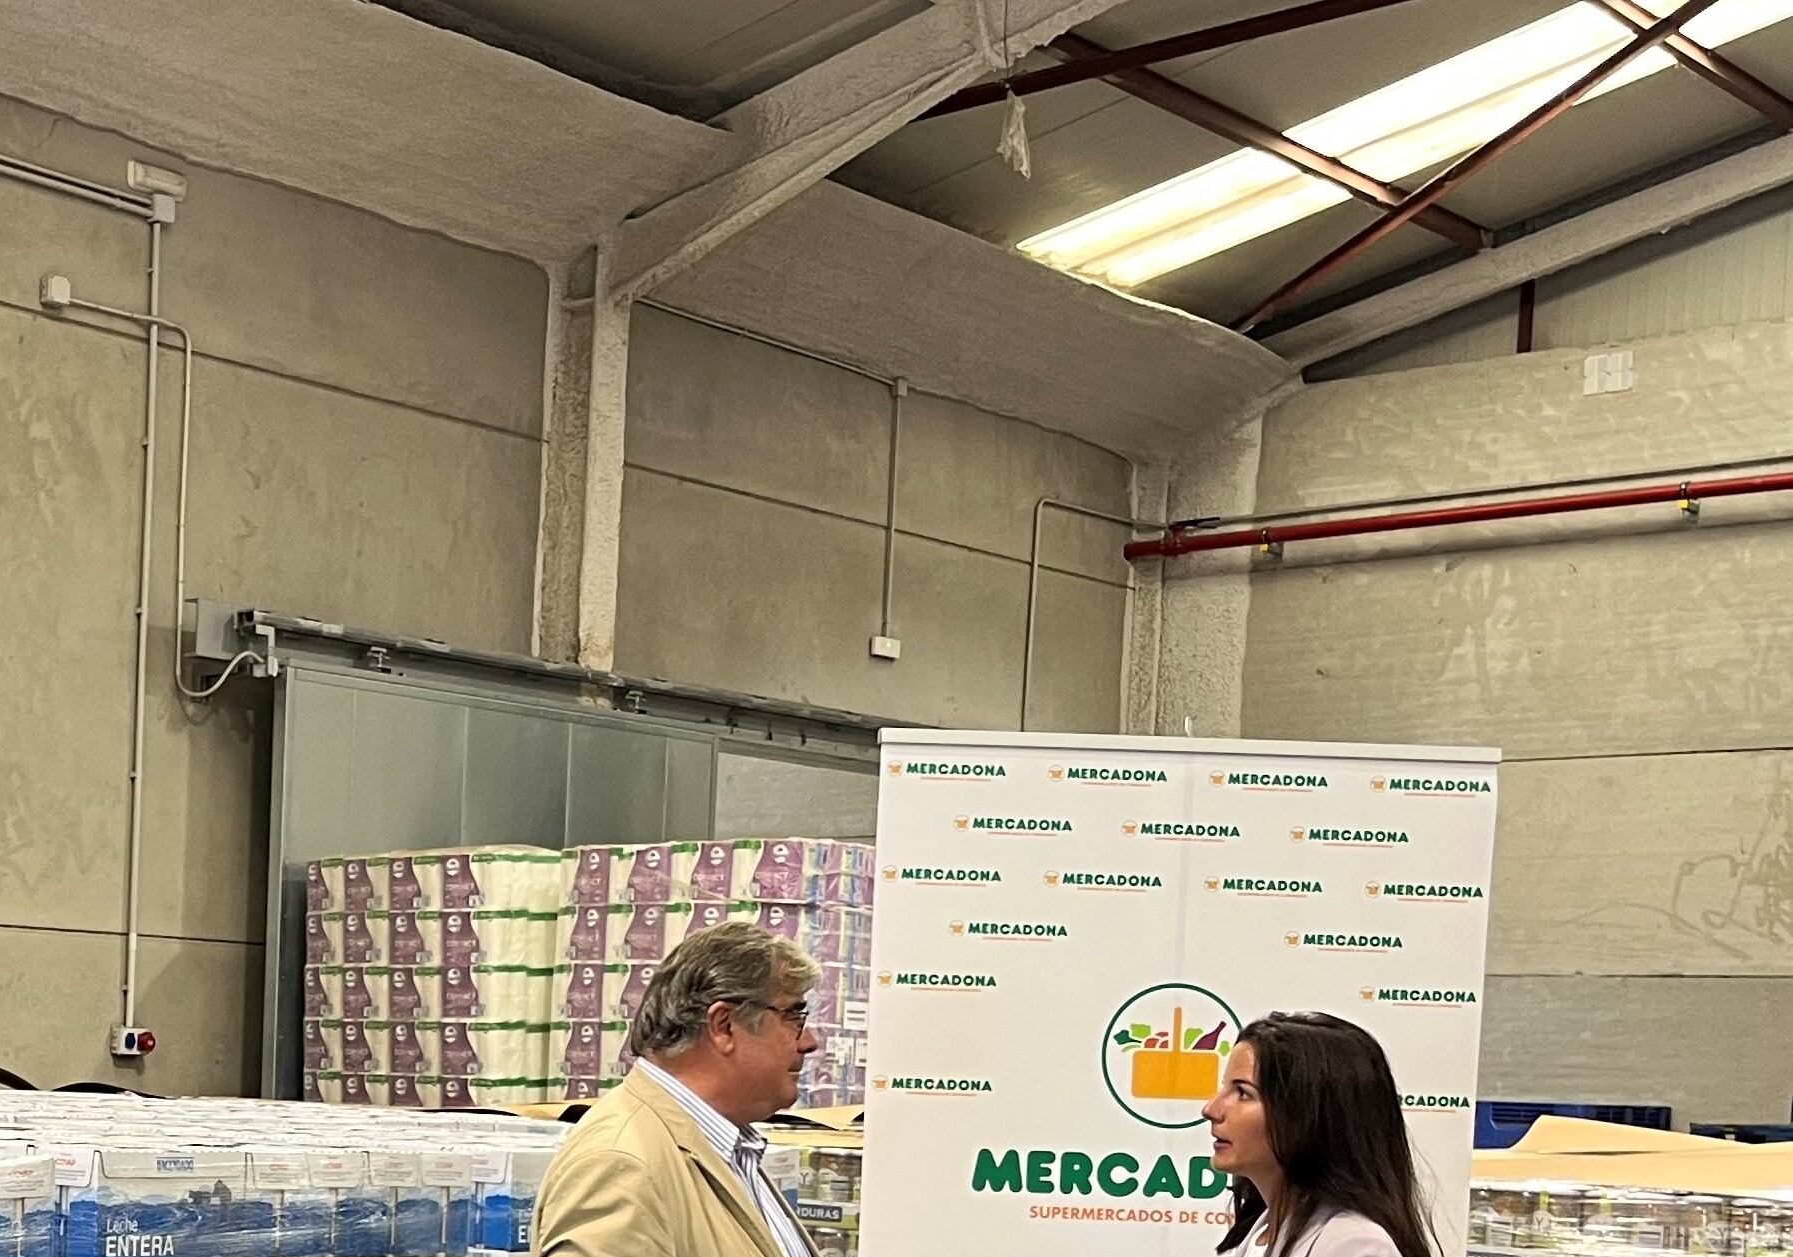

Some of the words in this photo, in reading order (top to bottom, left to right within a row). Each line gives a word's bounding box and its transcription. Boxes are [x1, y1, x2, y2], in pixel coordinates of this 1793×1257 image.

[906, 763, 1006, 777] MERCADONA
[1067, 767, 1167, 783] MERCADONA
[1228, 773, 1328, 788] MERCADONA
[1389, 778, 1491, 793] MERCADONA
[972, 818, 1073, 832] MERCADONA
[1140, 823, 1241, 838] MERCADONA
[1308, 828, 1409, 843] MERCADONA
[901, 869, 1001, 883] MERCADONA
[1062, 874, 1162, 888] MERCADONA
[1222, 879, 1323, 893] MERCADONA
[1383, 884, 1484, 899] MERCADONA
[968, 923, 1068, 937] MERCADONA
[1303, 935, 1403, 949] MERCADONA
[896, 974, 997, 988] MERCADONA
[1378, 989, 1476, 1003] MERCADONA
[891, 1078, 992, 1093] MERCADONA
[971, 1149, 1228, 1199] MERCAD
[1029, 1206, 1172, 1223] SUPERMERCADOS
[1179, 1211, 1198, 1224] DE
[107, 1218, 138, 1233] Leche
[106, 1235, 174, 1257] ENTERA
